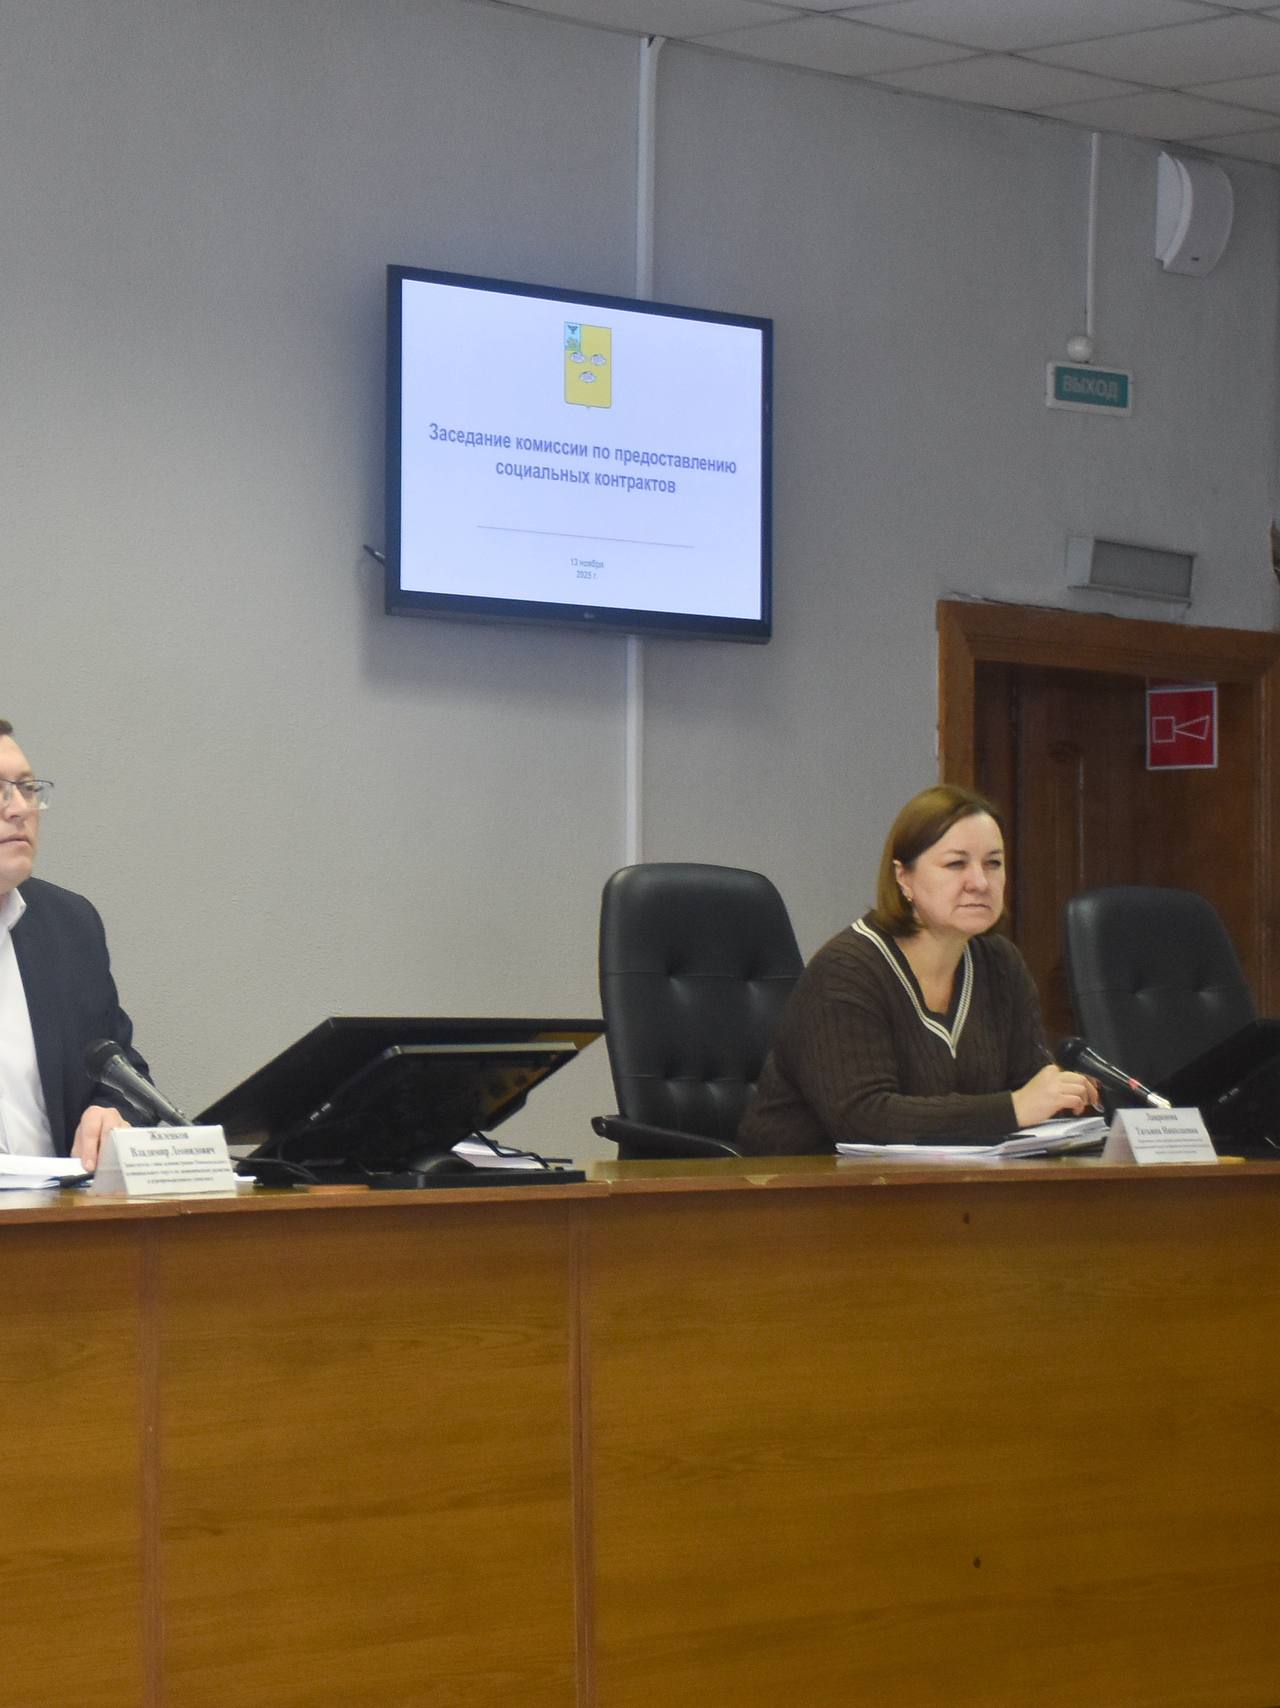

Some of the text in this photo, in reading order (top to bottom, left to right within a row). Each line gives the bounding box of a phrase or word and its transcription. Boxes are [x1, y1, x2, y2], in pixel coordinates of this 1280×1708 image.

[428, 422, 737, 474] Заседание комиссии по предоставлению
[495, 460, 676, 494] социальных контрактов
